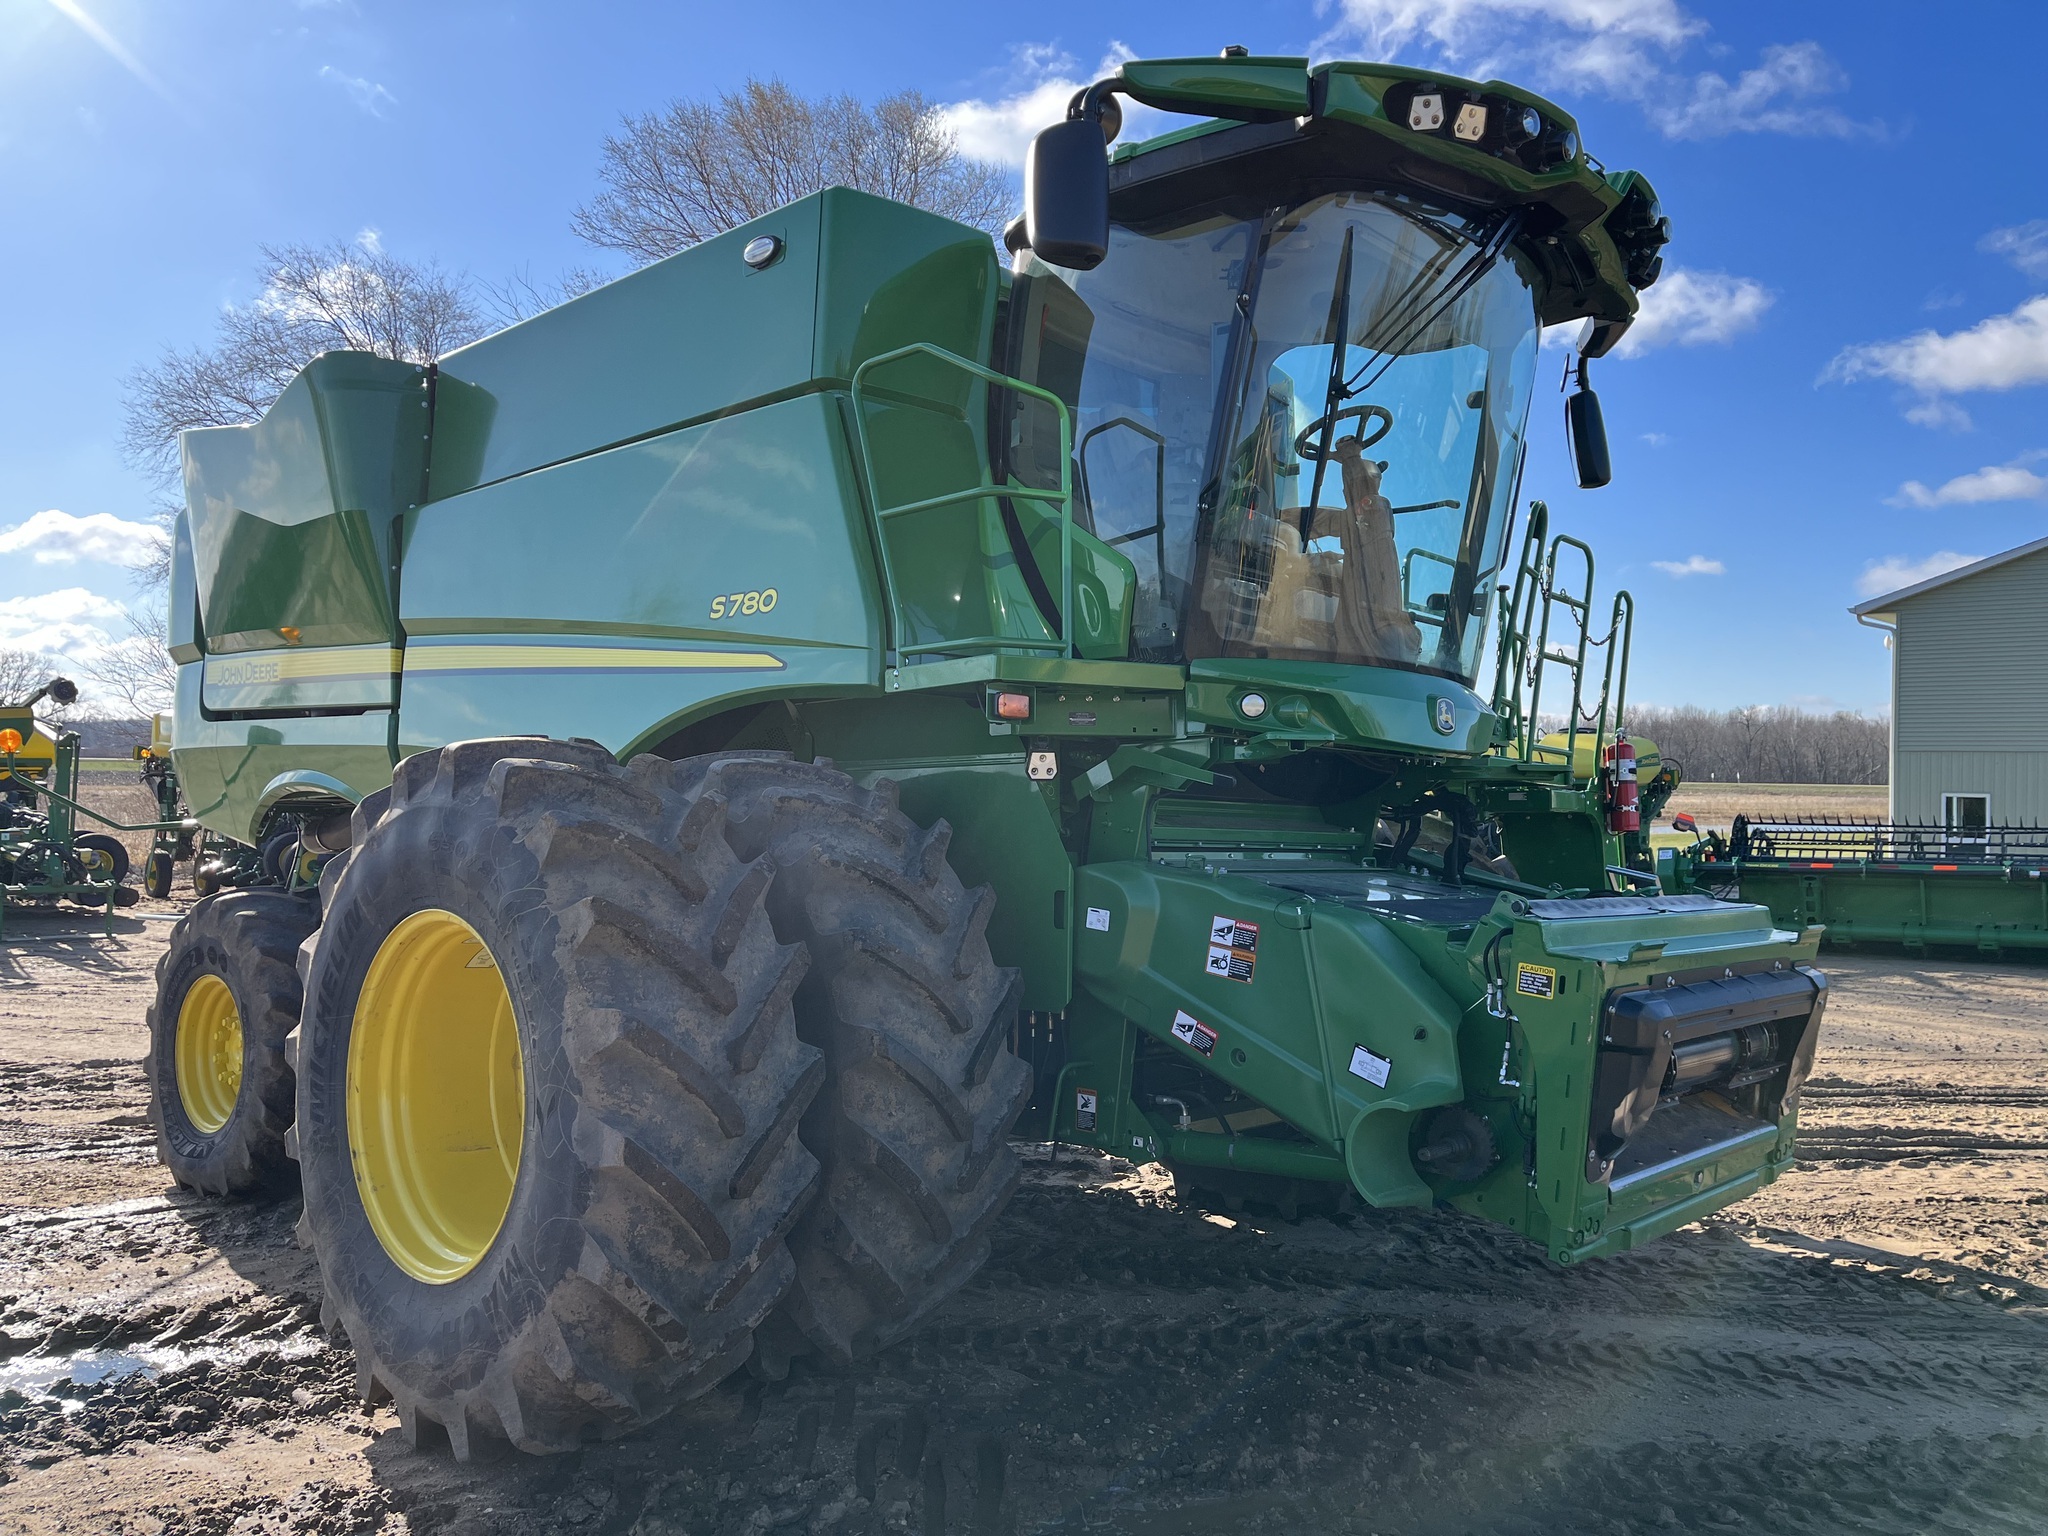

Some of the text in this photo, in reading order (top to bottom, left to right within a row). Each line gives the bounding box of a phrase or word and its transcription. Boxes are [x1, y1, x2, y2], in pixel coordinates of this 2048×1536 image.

[709, 587, 778, 620] S780
[218, 661, 279, 683] JOHN DEERE
[1525, 964, 1554, 975] CAUTION
